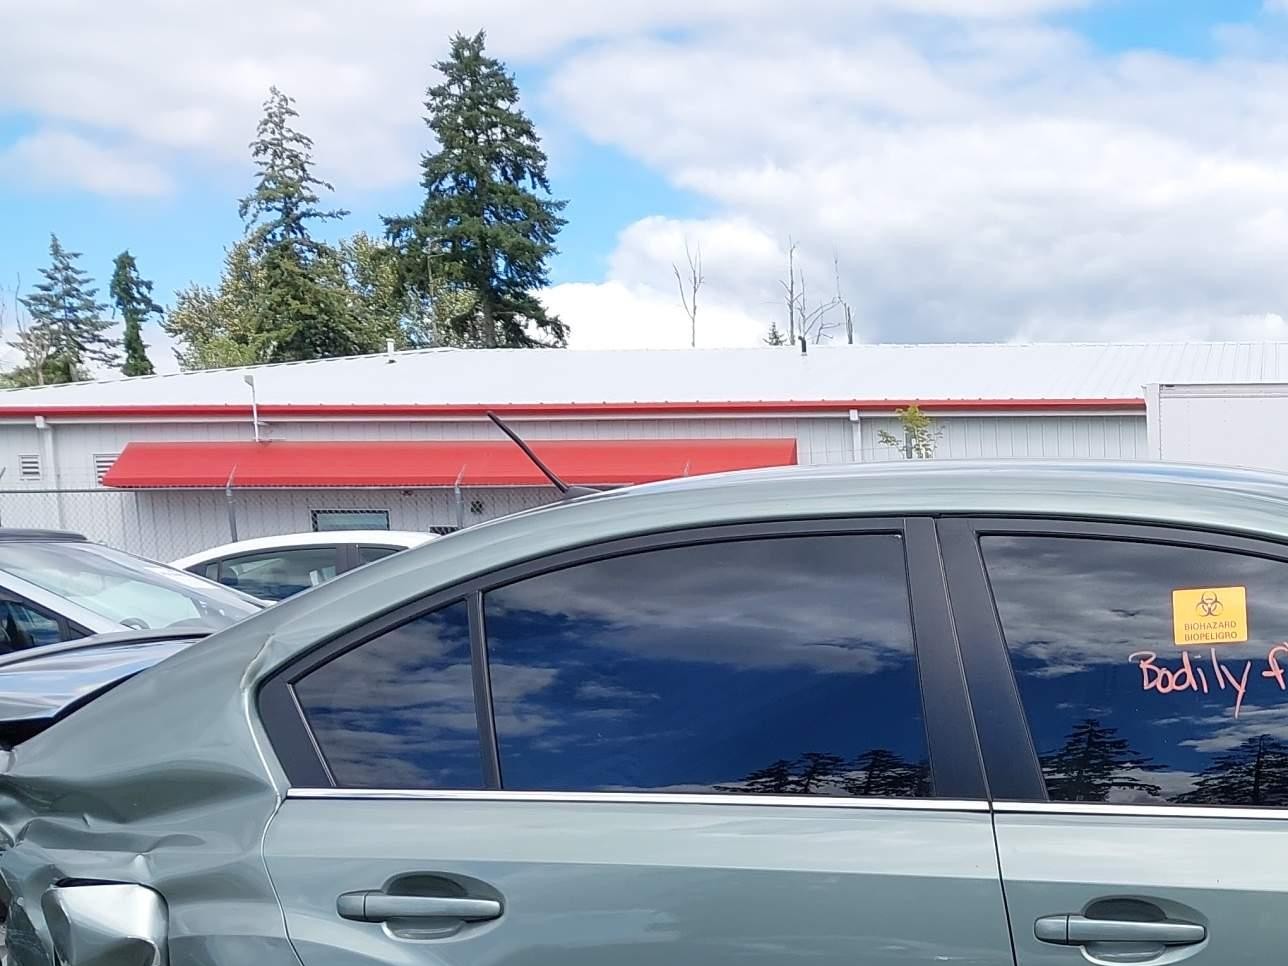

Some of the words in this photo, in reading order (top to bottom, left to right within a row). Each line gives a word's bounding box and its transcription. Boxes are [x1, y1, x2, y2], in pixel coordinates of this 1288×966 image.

[1184, 620, 1237, 631] BIOHAZARD
[1184, 631, 1238, 642] BIOPELIGRO
[1128, 647, 1252, 720] Bodily
